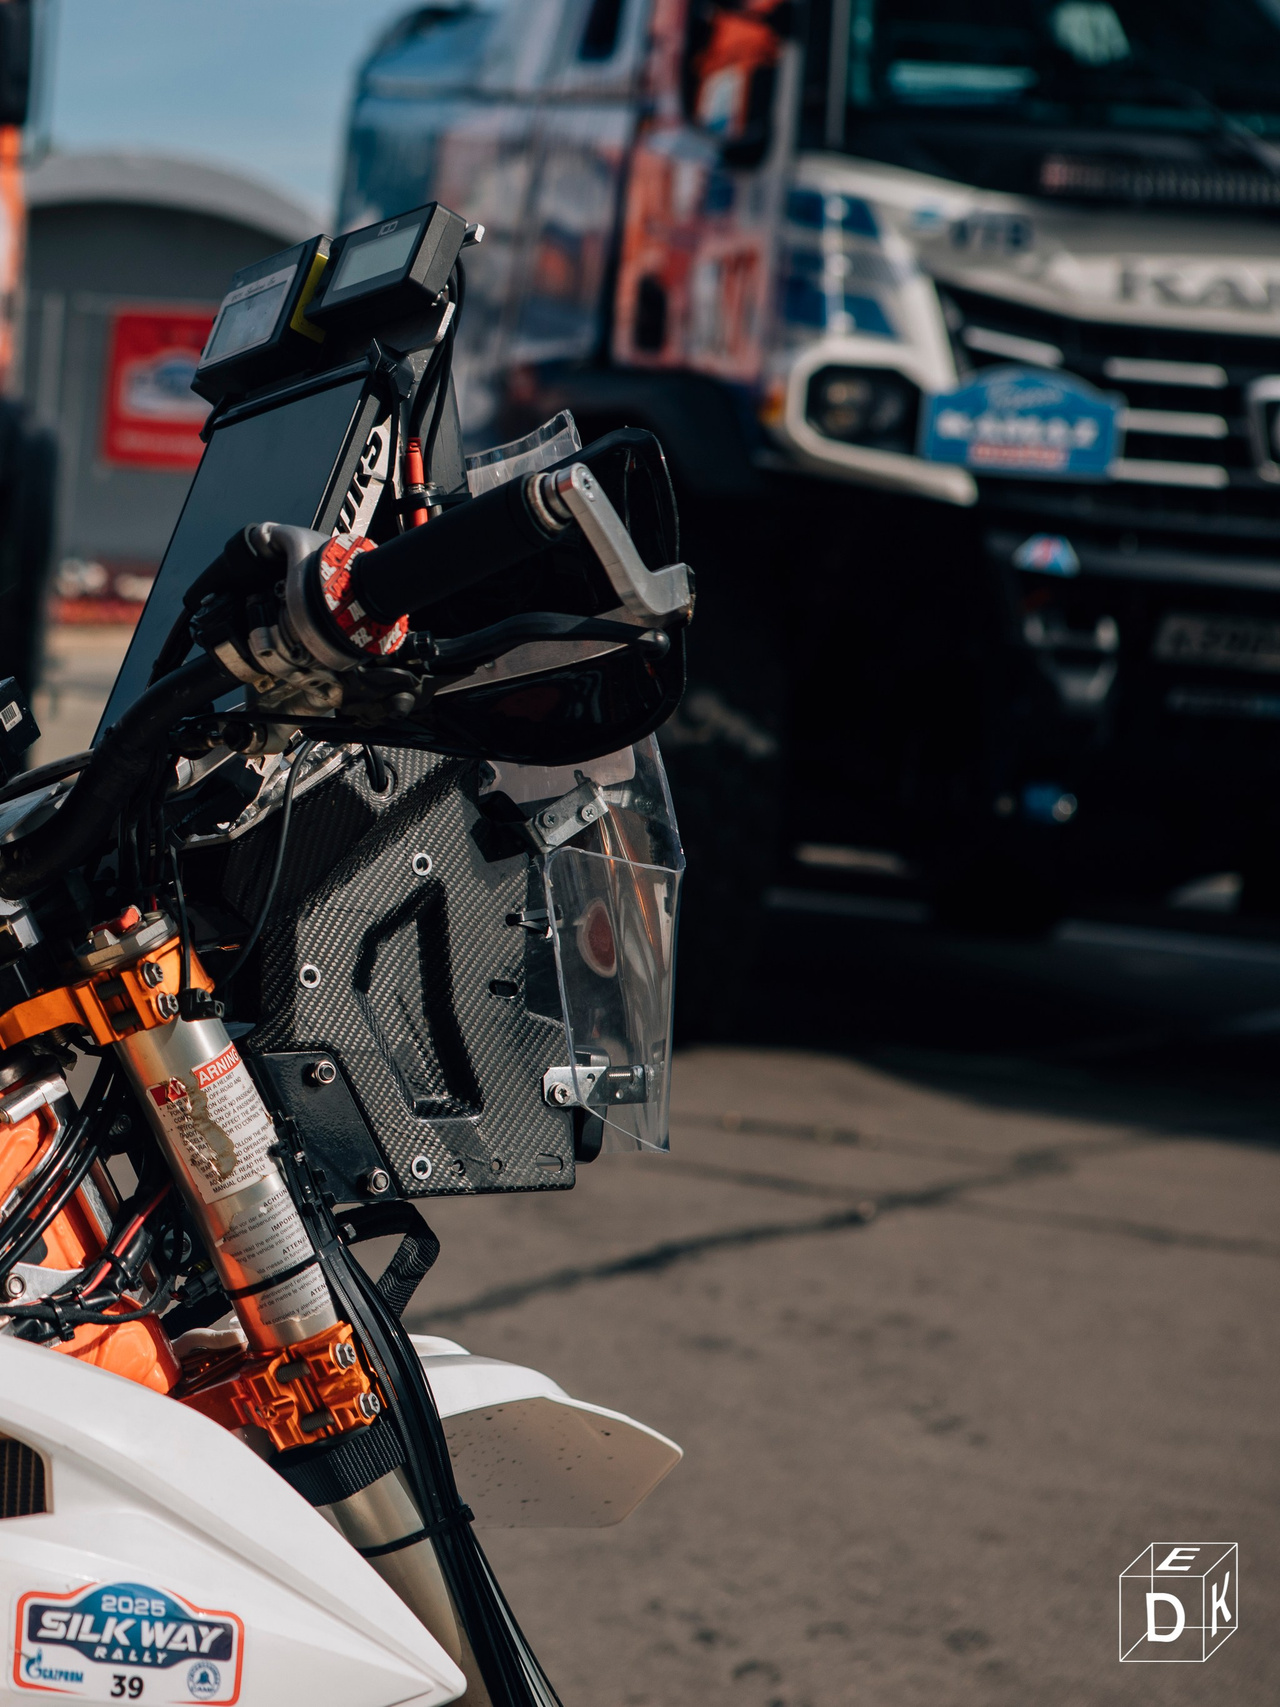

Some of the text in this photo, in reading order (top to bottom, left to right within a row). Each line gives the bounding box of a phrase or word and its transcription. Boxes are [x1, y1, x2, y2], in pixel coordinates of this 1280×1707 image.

[1117, 254, 1280, 306] KA
[235, 1134, 253, 1149] OLLOW
[212, 1179, 237, 1193] MANUAL
[263, 1188, 288, 1207] ACHTUN
[271, 1211, 300, 1232] IMPORTA
[256, 1243, 275, 1257] vehicle
[310, 1284, 326, 1297] ATEN
[101, 1594, 166, 1617] 2025
[37, 1610, 225, 1654] SILK WAY
[94, 1646, 169, 1665] RALLY
[110, 1674, 145, 1699] 39
